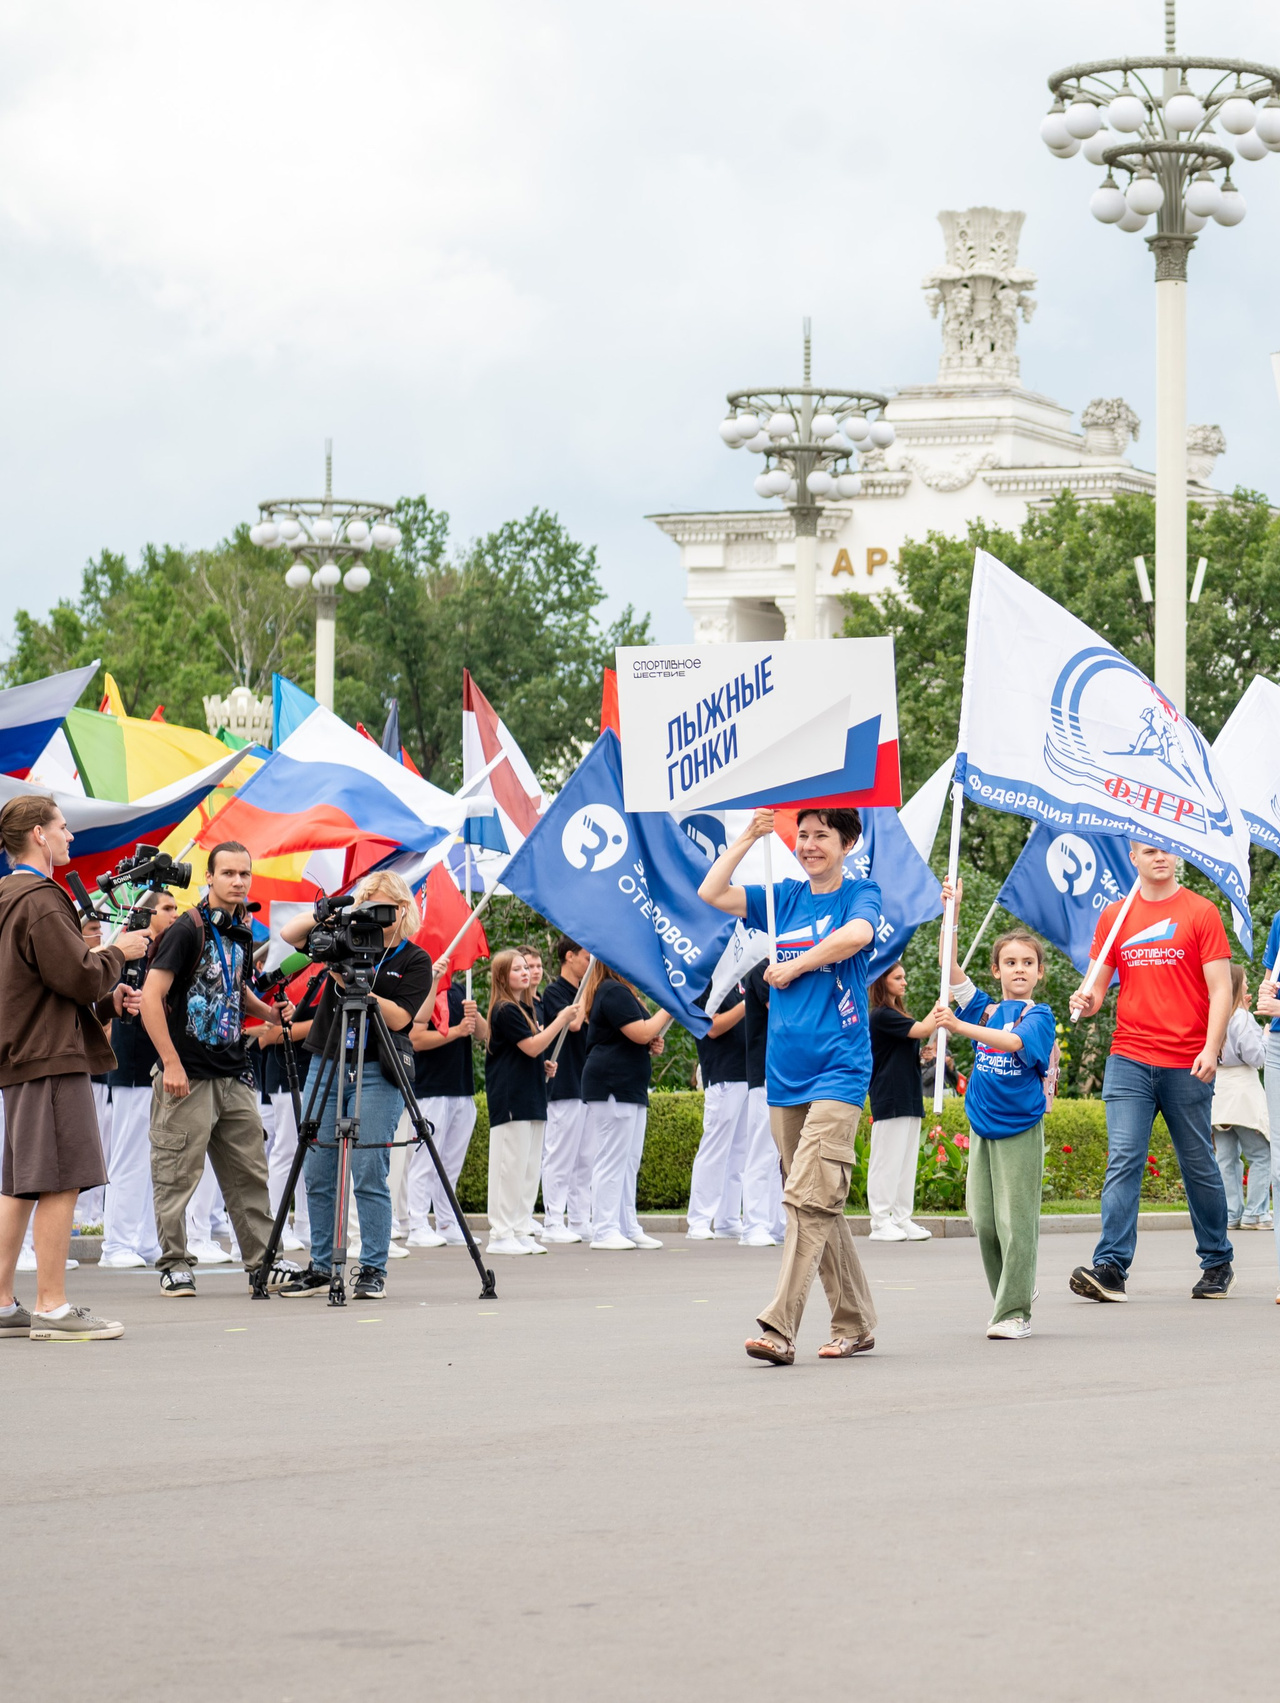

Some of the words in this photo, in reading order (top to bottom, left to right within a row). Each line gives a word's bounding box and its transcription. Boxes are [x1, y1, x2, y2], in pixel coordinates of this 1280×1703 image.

[831, 547, 903, 577] АР
[633, 671, 686, 679] ШЕСТВИЕ
[666, 655, 774, 759] ЛЫЖНЫЕ
[668, 723, 738, 801] ГОНКИ
[1104, 777, 1195, 823] ФЛГР
[968, 774, 1073, 825] Федерация
[1171, 842, 1225, 877] гонок
[113, 874, 132, 885] RONIN
[1127, 959, 1177, 967] ШЕСТВИЕ
